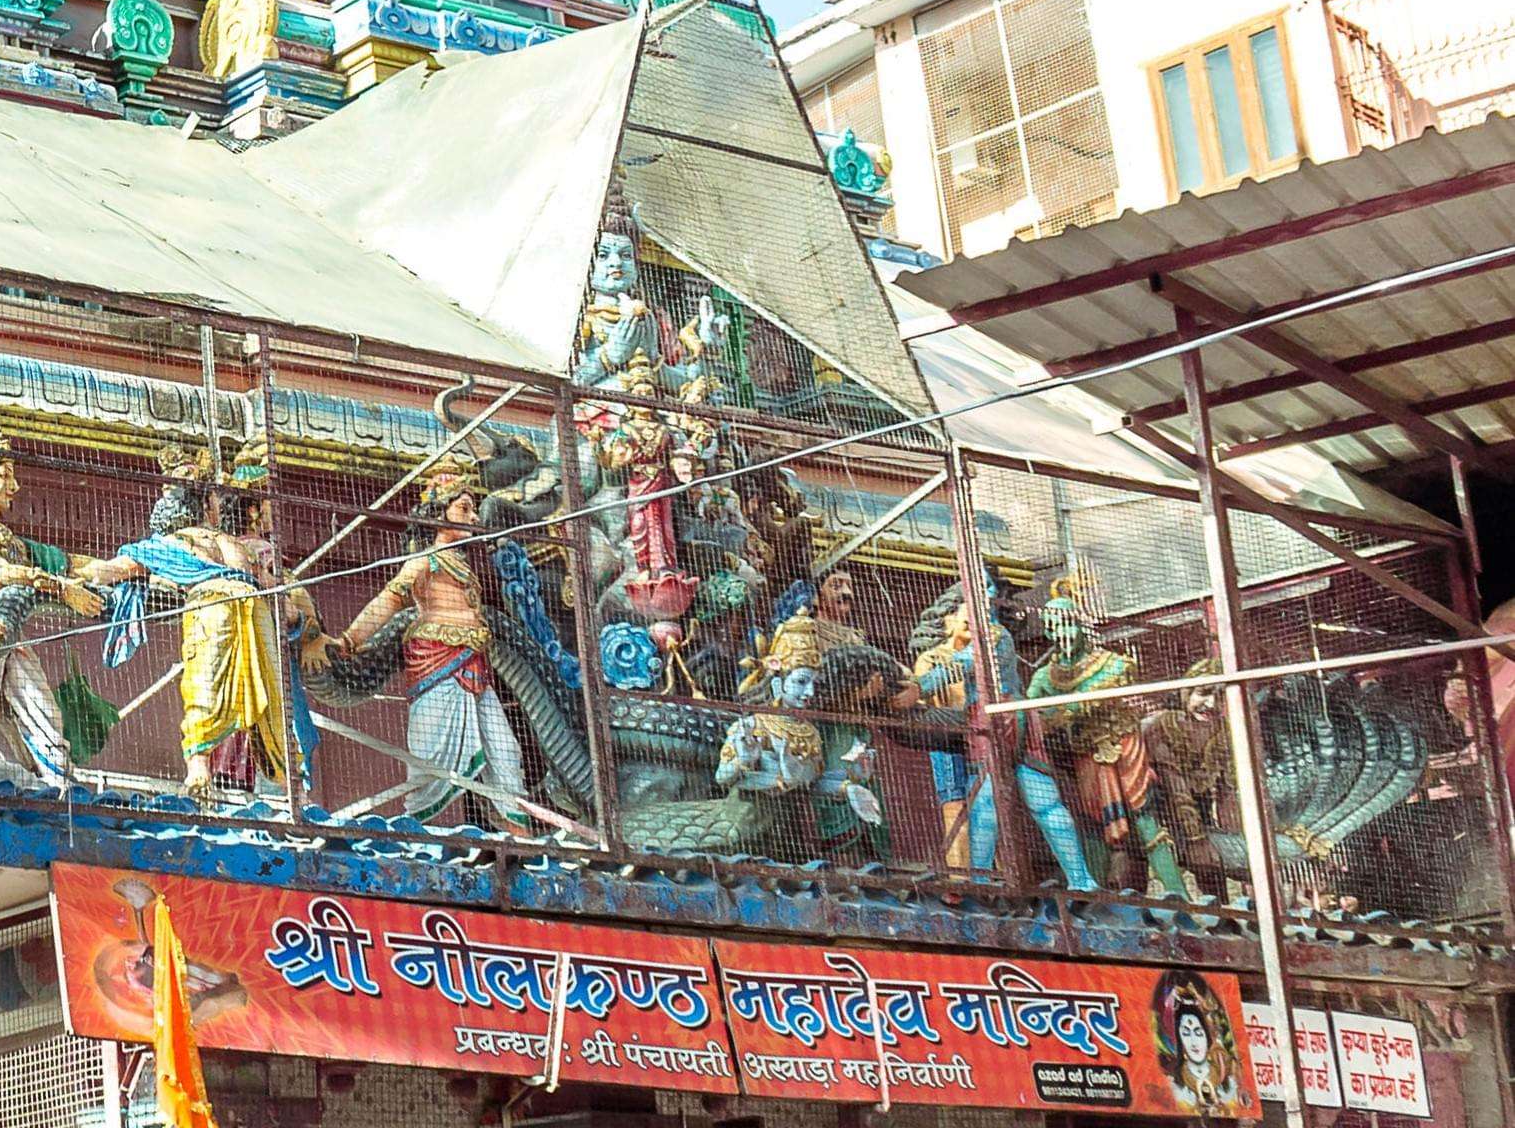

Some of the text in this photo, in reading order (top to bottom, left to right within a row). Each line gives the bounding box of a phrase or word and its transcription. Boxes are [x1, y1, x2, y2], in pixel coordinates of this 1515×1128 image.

[264, 897, 1130, 1056] श्री नीलकण्ठ महादेव मन्दिर
[581, 1029, 622, 1068] श्री
[623, 1032, 733, 1077] पंचायती
[840, 1051, 975, 1089] महनिर्वाणी
